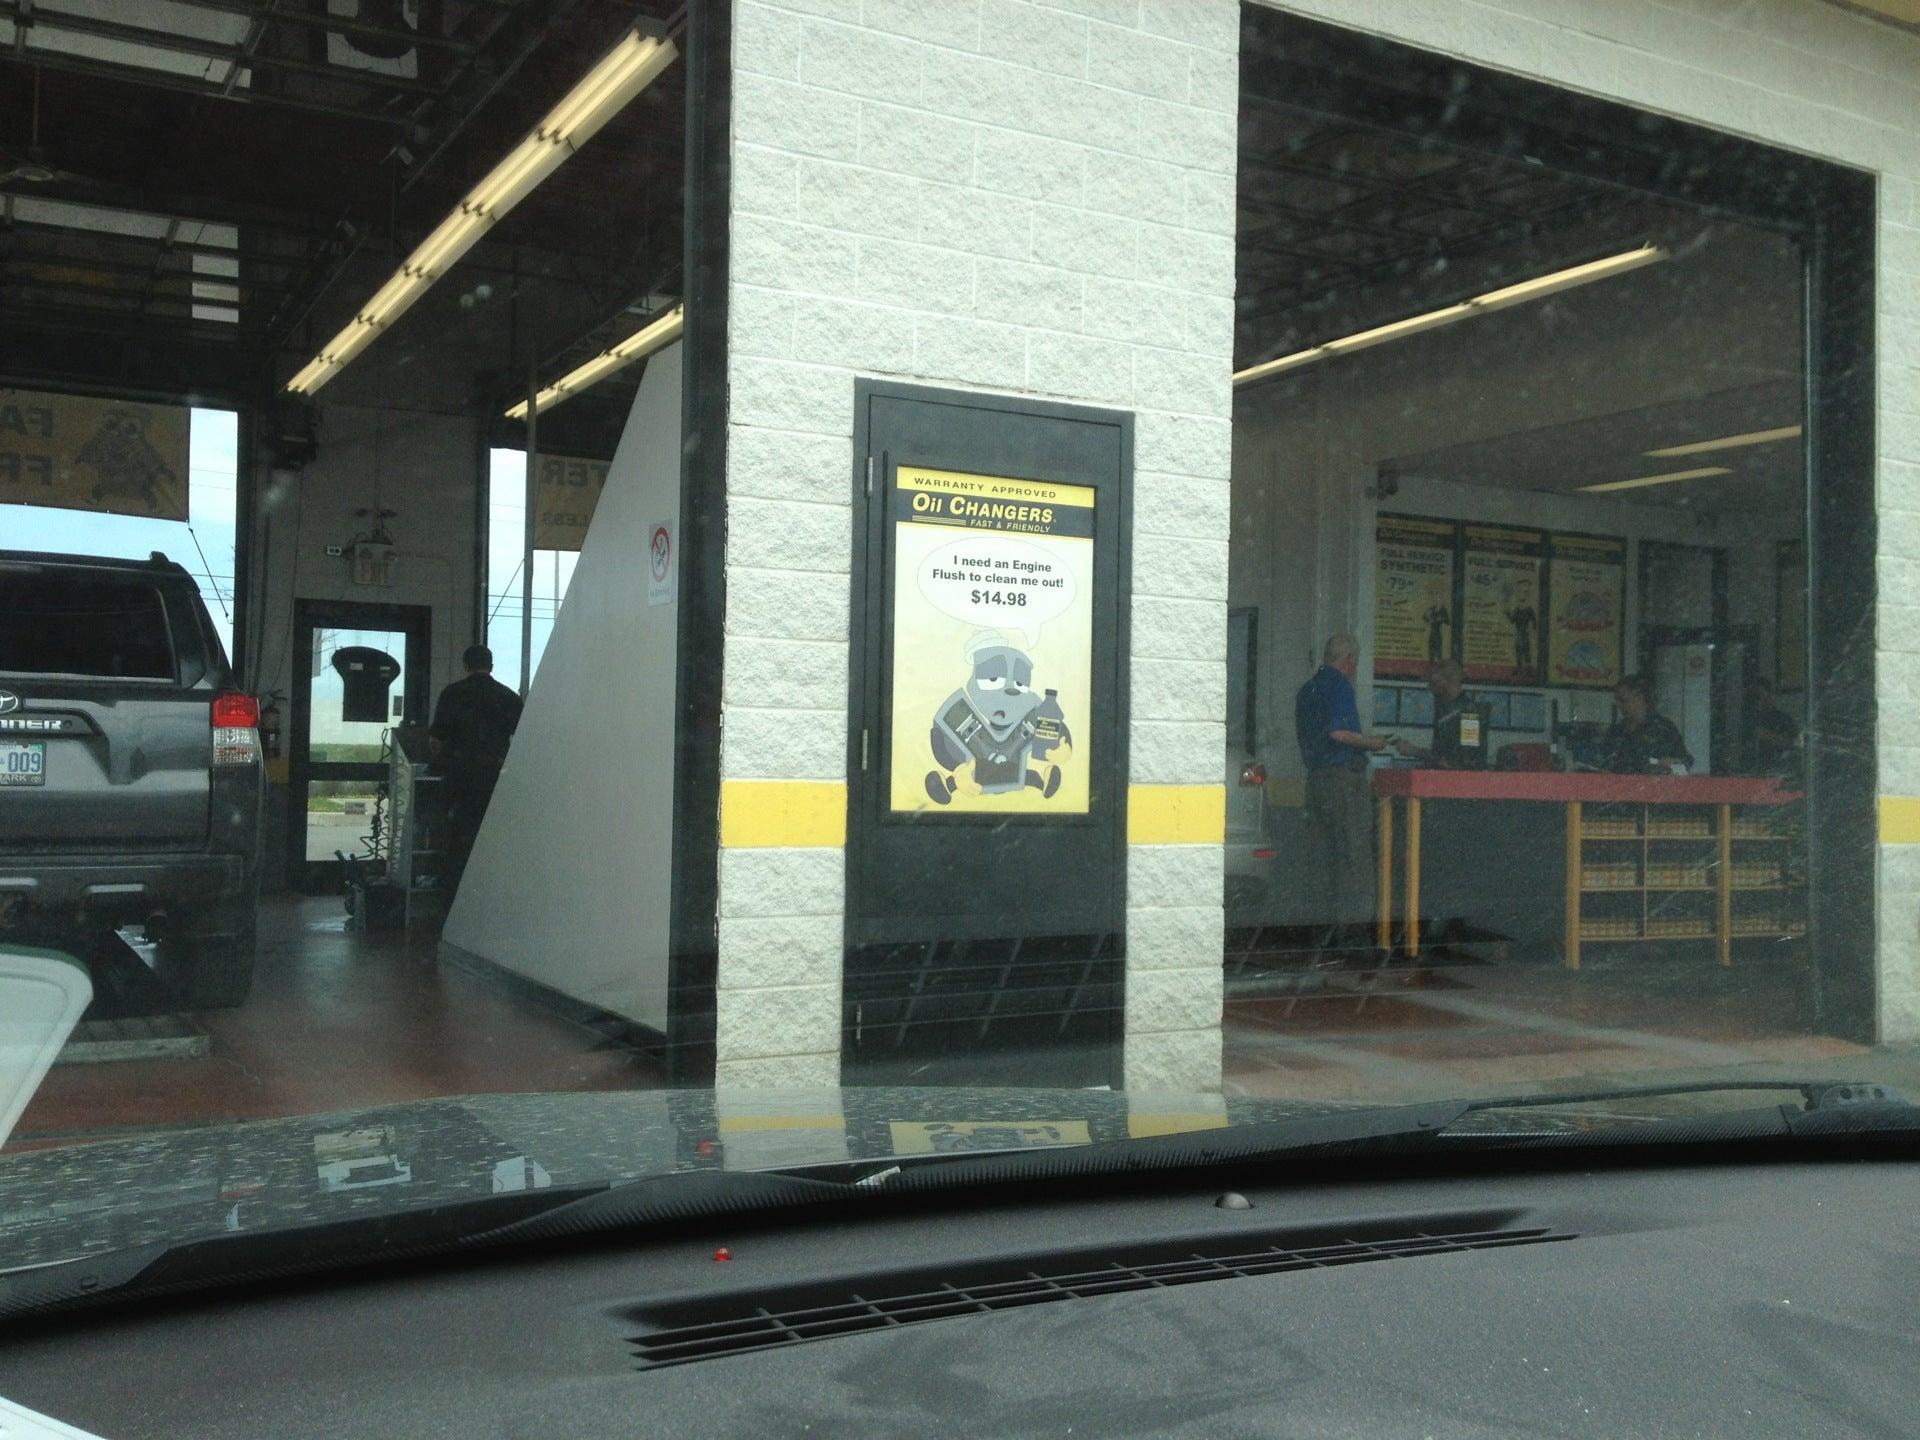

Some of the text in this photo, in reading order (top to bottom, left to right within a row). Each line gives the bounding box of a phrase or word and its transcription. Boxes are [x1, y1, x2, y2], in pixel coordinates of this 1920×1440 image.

[914, 477, 1056, 500] WARRANTY APPROVED
[912, 492, 942, 513] Oil
[970, 519, 1051, 534] FAST & FRIENDLY
[953, 555, 1052, 573] I need an Engine
[1379, 559, 1446, 575] SYNTHETIC
[932, 569, 1064, 588] Flush to clean me out!
[971, 589, 1028, 607] $14.98
